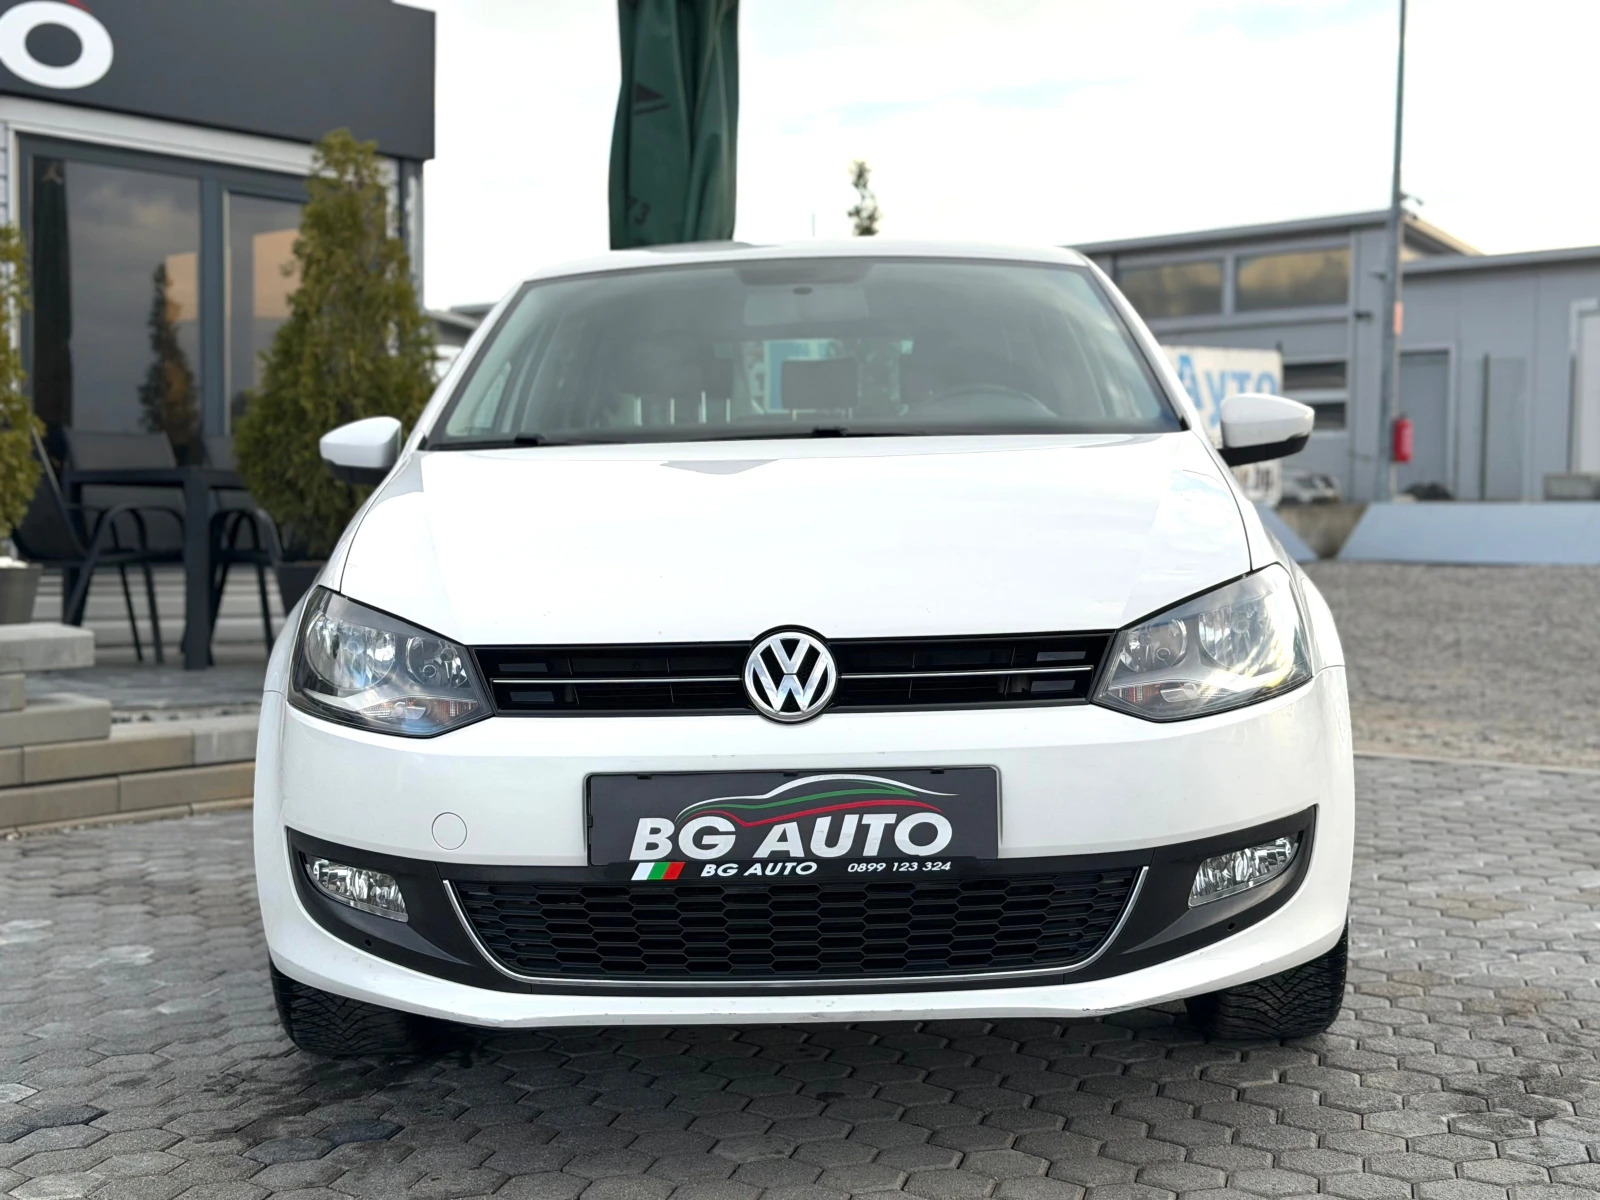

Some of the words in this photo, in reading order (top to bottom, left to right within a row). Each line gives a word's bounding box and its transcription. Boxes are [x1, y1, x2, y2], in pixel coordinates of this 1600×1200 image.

[629, 816, 737, 861] BG
[753, 811, 953, 859] AUTO
[700, 863, 739, 877] BG
[743, 862, 818, 876] AUTO
[847, 862, 887, 873] 0899
[892, 862, 919, 872] 123
[922, 861, 952, 871] 324
